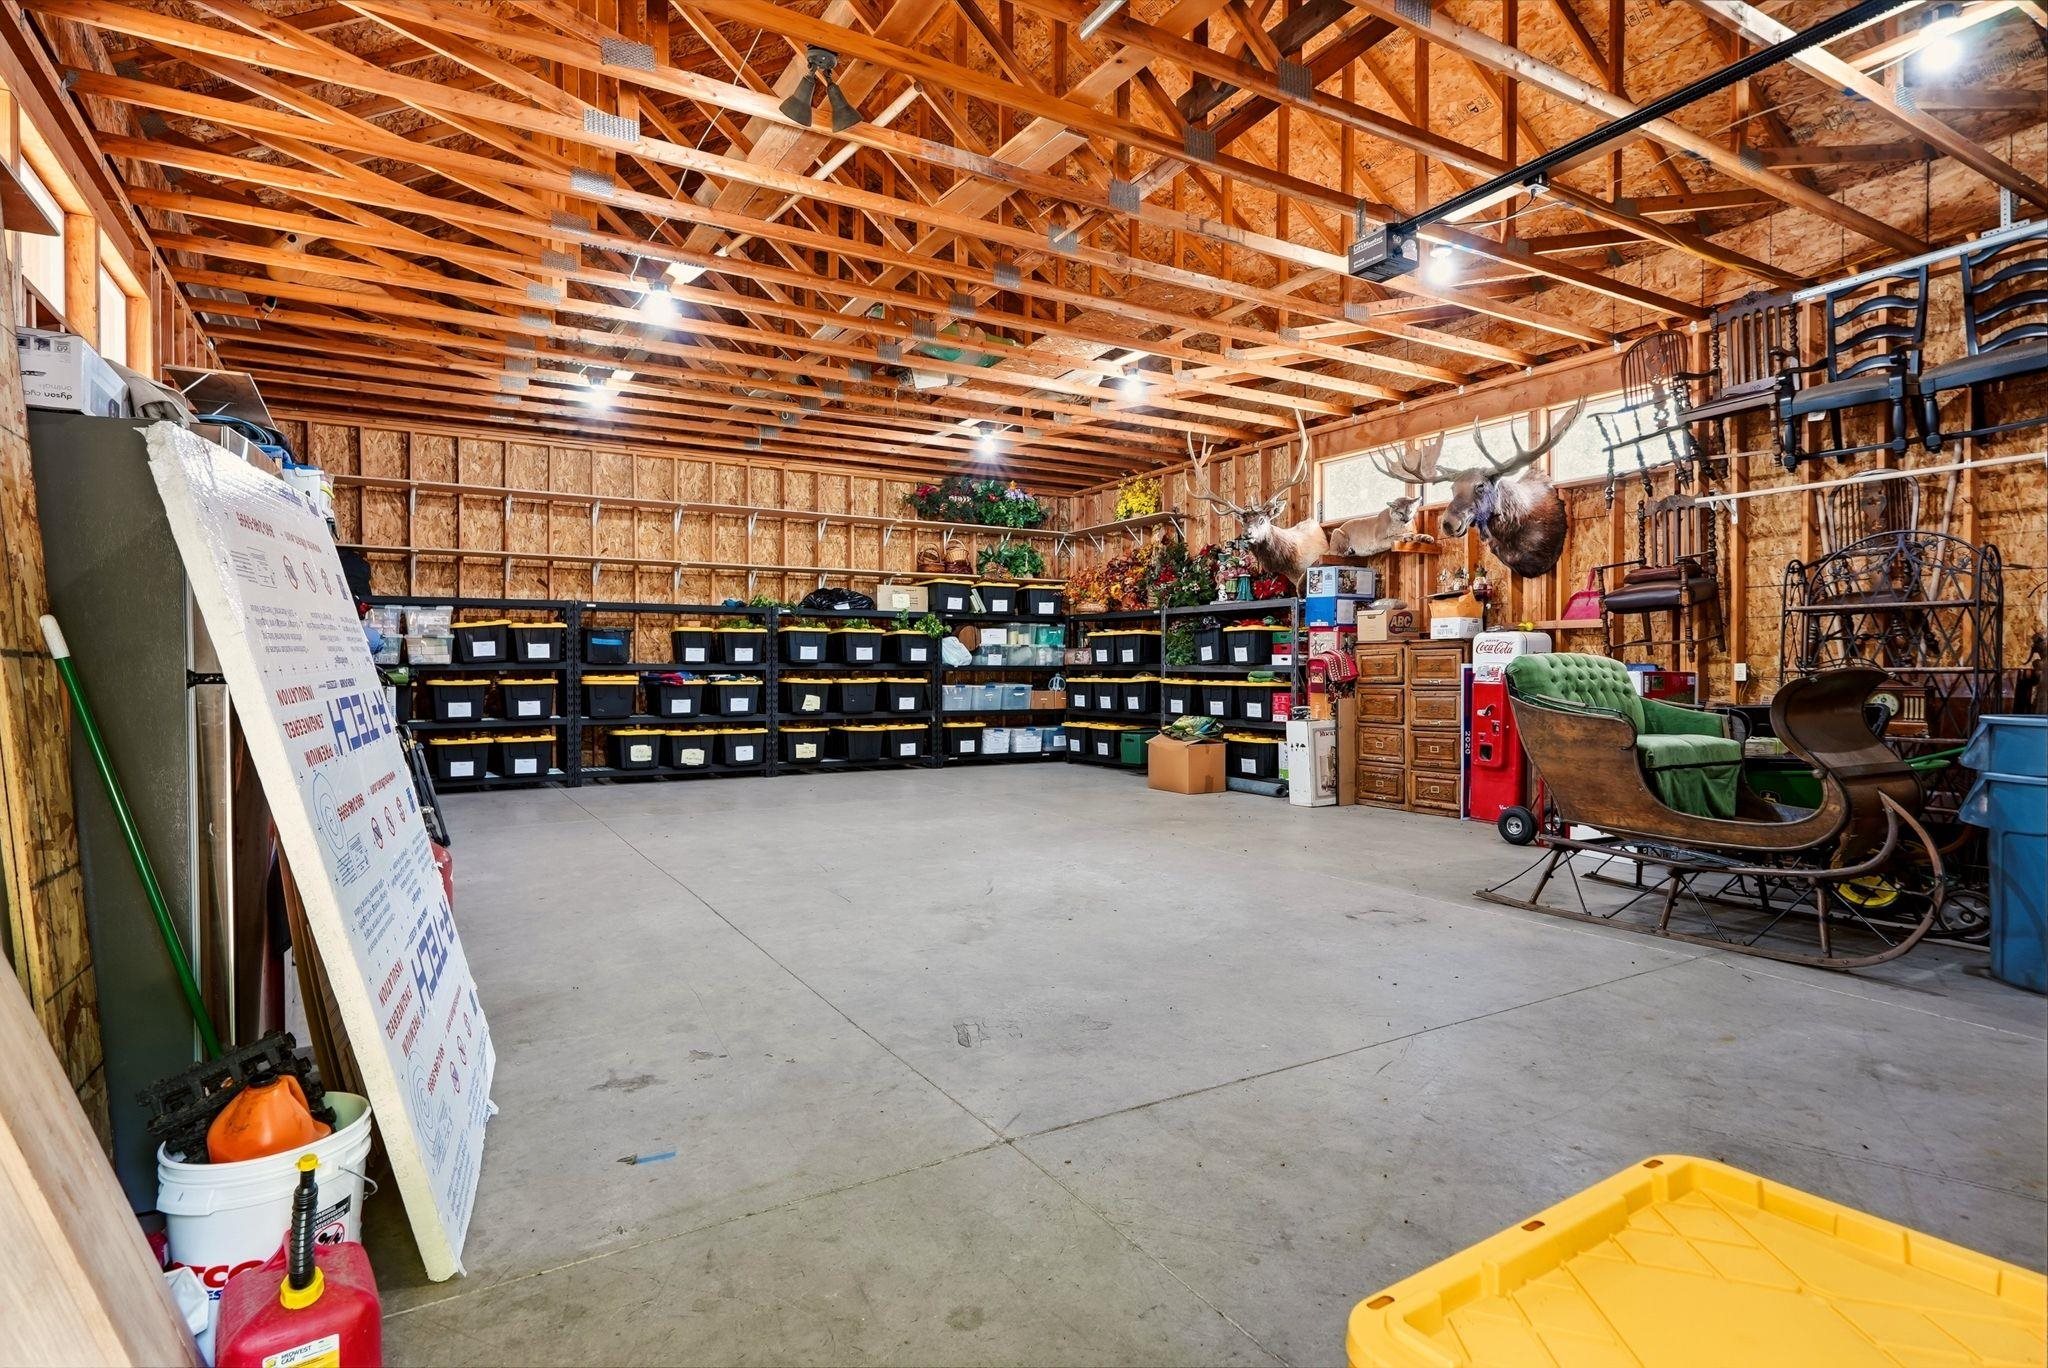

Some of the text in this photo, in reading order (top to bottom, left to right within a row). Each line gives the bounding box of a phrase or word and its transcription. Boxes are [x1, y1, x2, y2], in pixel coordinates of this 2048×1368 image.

[24, 389, 73, 401] dyson cyc
[1391, 614, 1411, 628] ABC
[1475, 641, 1514, 655] Coca-Cola
[276, 685, 315, 707] INSULATION
[283, 713, 325, 739] ENGINEERED
[326, 688, 392, 756] R-TECH
[304, 743, 334, 768] PREMIUM
[411, 894, 455, 1014] R-TECH
[378, 957, 404, 1007] INSULATION
[386, 980, 413, 1040] ENGINEERED
[402, 1011, 421, 1058] PREMIUM
[281, 1345, 313, 1359] MIDWEST
[281, 1356, 295, 1365] CAN
